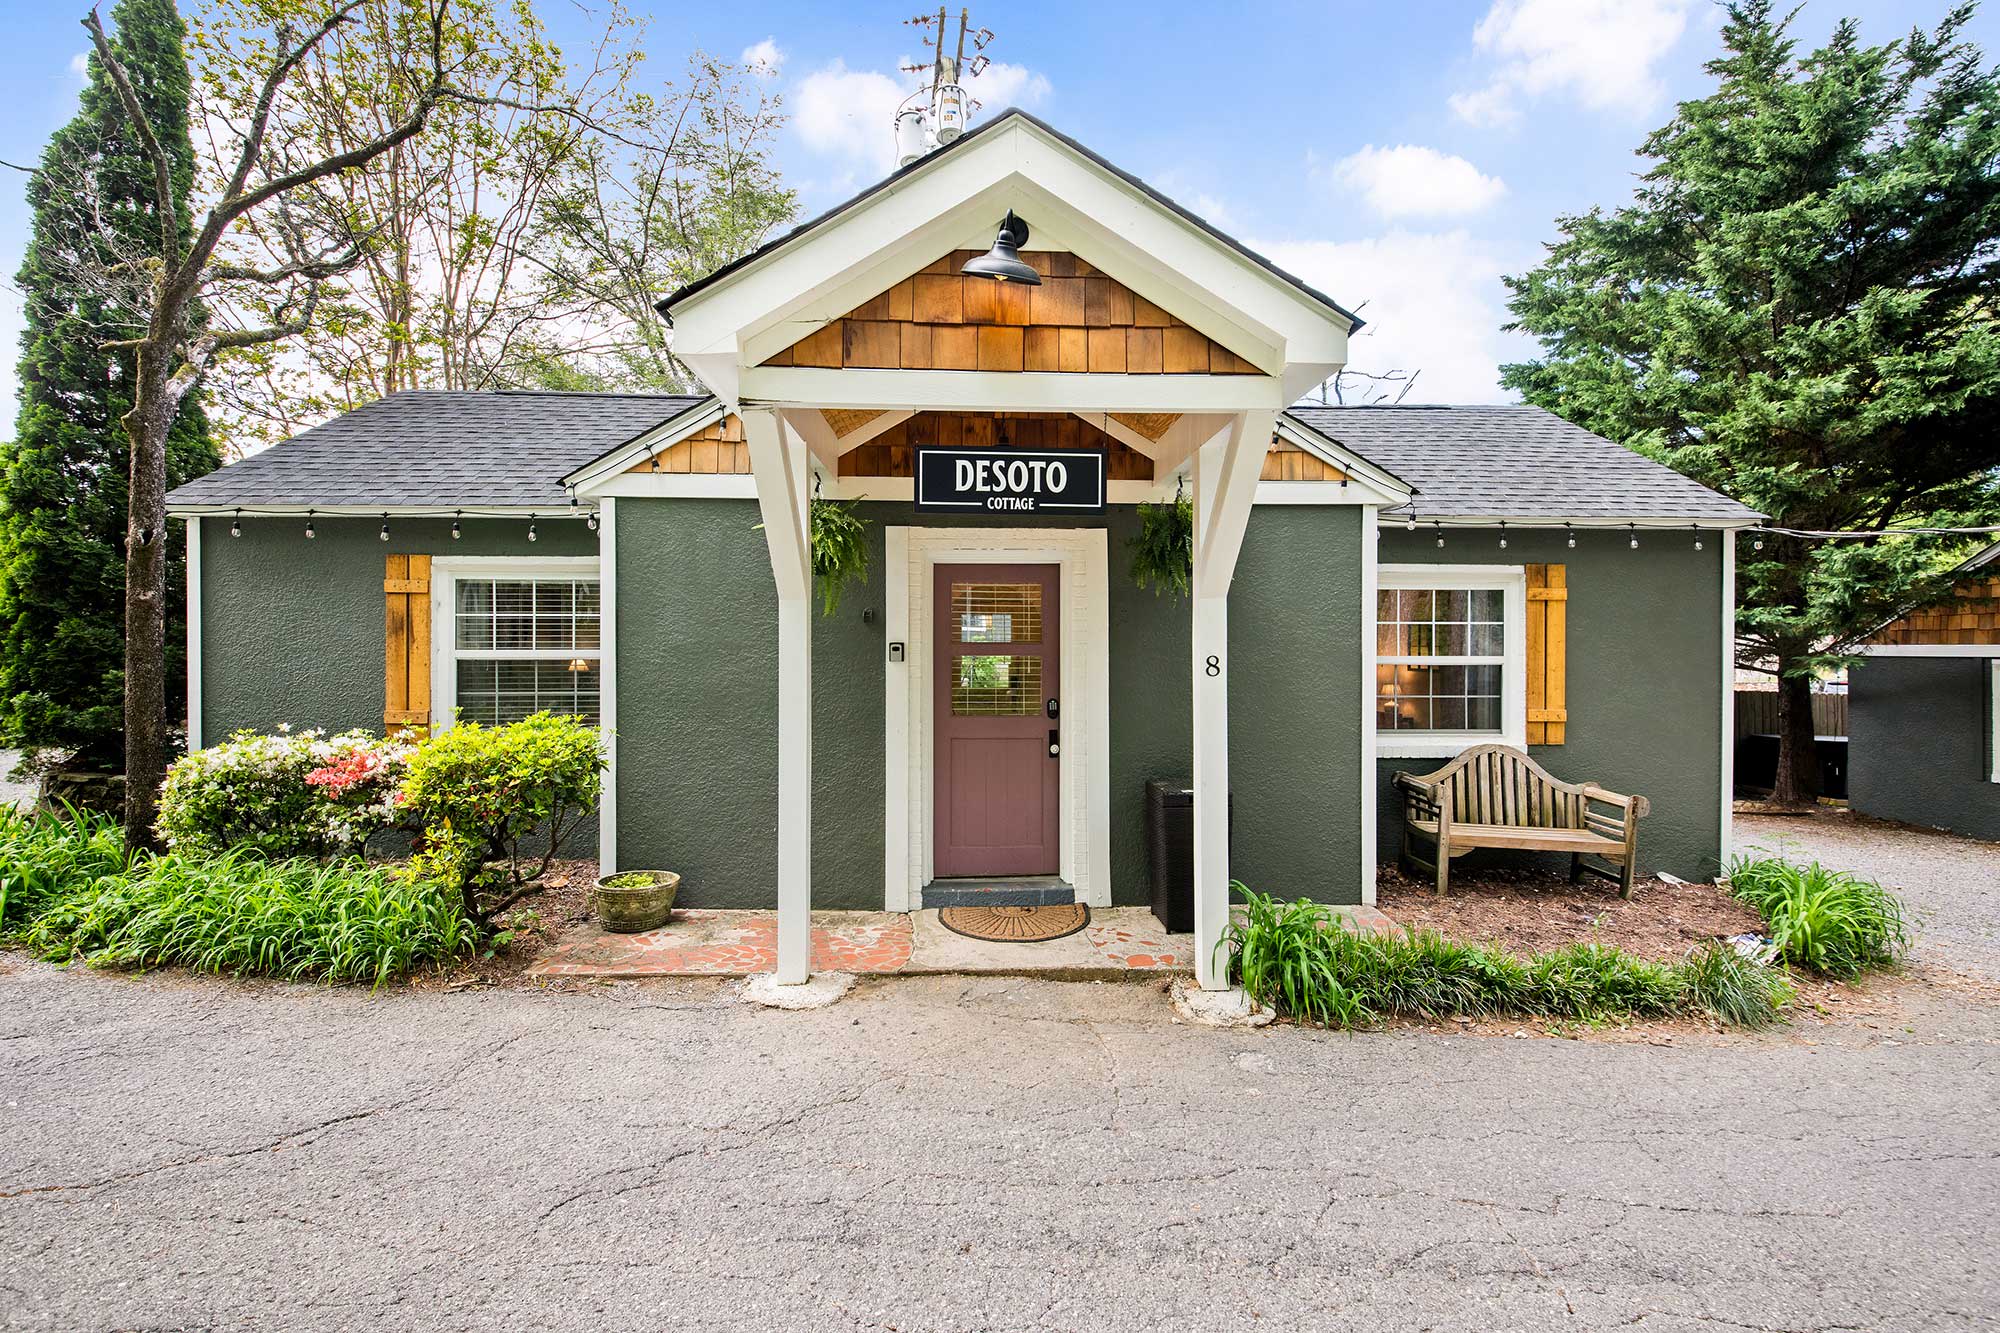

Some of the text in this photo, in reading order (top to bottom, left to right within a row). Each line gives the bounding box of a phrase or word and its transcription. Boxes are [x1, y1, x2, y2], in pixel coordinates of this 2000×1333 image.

[955, 459, 1067, 493] DESOTO
[987, 497, 1035, 510] COTTAGE
[1206, 655, 1220, 677] 8
